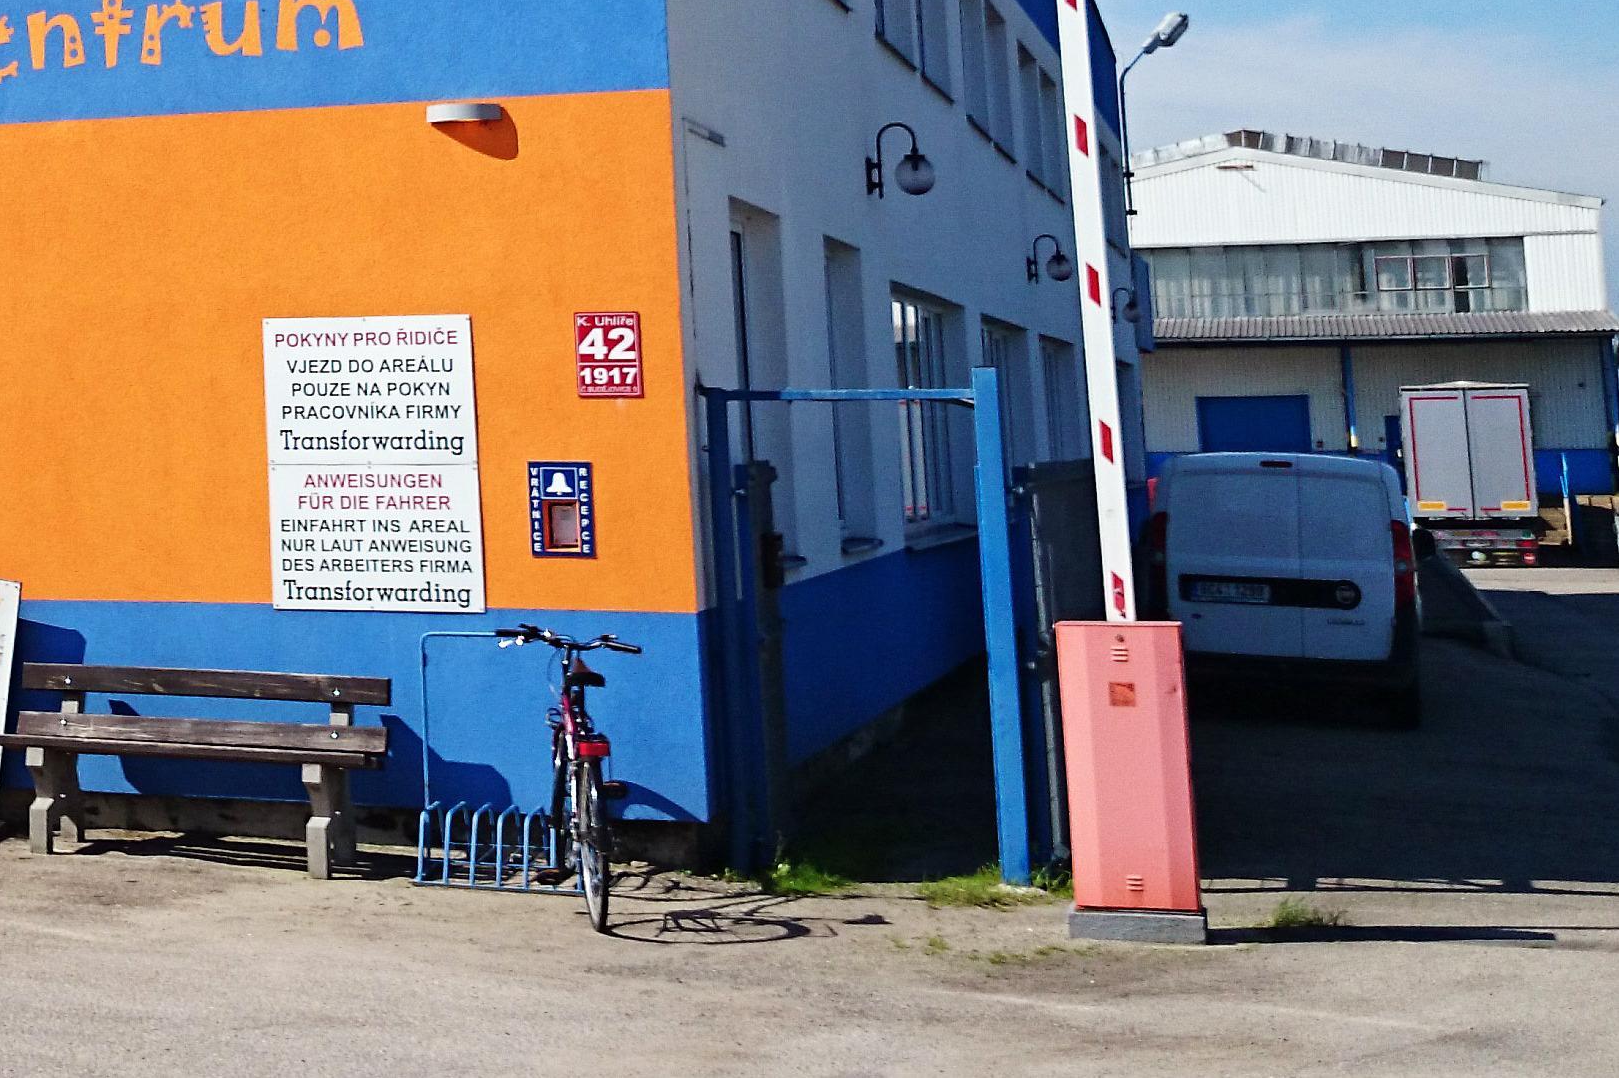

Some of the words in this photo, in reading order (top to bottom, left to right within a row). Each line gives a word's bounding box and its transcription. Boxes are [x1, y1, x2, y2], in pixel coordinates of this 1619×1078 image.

[275, 332, 348, 347] POKYNY
[353, 331, 391, 346] PRO
[397, 327, 458, 345] ŘIDIČE
[579, 327, 636, 359] 42
[287, 360, 342, 374] VJEZD
[349, 359, 374, 373] DO
[379, 355, 453, 373] AREÁLU
[580, 368, 636, 385] 1917
[292, 383, 350, 397] POUZE
[357, 383, 381, 396] NA
[387, 382, 450, 396] POKYN
[282, 402, 400, 420] PRACOVNÍKA
[406, 405, 461, 419] FIRMY
[280, 429, 465, 455] Transforwarding
[304, 473, 442, 488] ANWEISUNGEN
[298, 493, 333, 510] FÜR
[340, 495, 369, 510] DIE
[376, 495, 450, 510] FAHRER
[578, 467, 591, 553] RECEPCE
[281, 519, 366, 532] EINFAHRT
[373, 519, 400, 533] INS
[409, 519, 470, 533] AREAL
[281, 539, 316, 552] NUR
[321, 539, 363, 552] LAUT
[368, 539, 472, 553] ANWEISUNG
[283, 558, 314, 572] DES
[319, 558, 413, 572] ARBEITERS
[419, 559, 472, 573] FIRMA
[283, 579, 471, 608] Transforwarding
